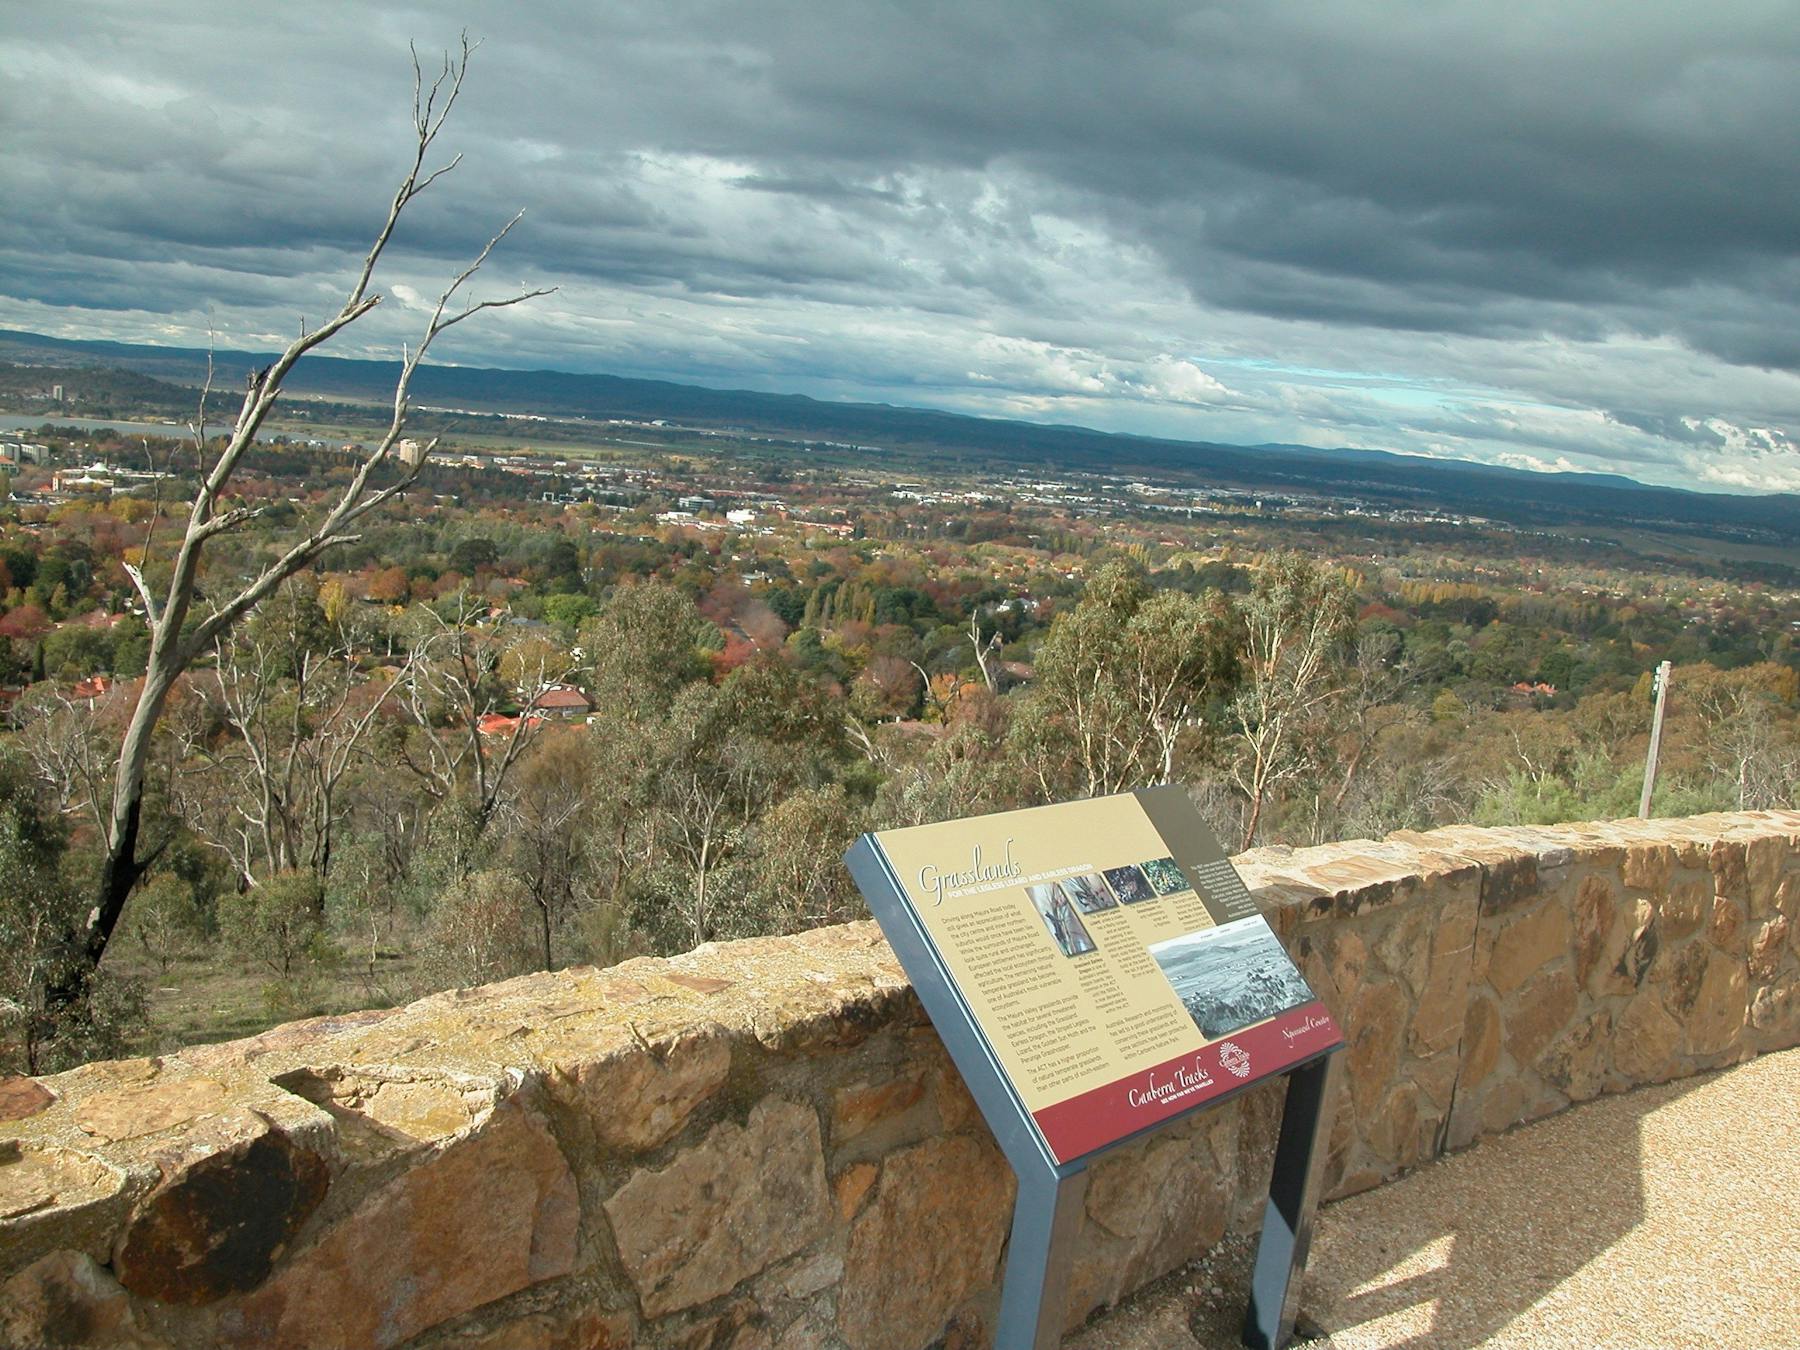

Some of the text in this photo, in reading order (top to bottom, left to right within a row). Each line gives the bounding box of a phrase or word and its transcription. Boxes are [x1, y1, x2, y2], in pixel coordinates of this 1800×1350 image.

[918, 836, 1022, 907] Grasslands
[946, 889, 963, 899] FOR
[960, 886, 978, 896] THE
[975, 880, 1006, 892] LEGLESS
[1003, 875, 1029, 886] LIZARD
[1026, 873, 1042, 882] AND
[1066, 862, 1094, 873] DRAGON
[1128, 1055, 1210, 1108] Canberra Tracks
